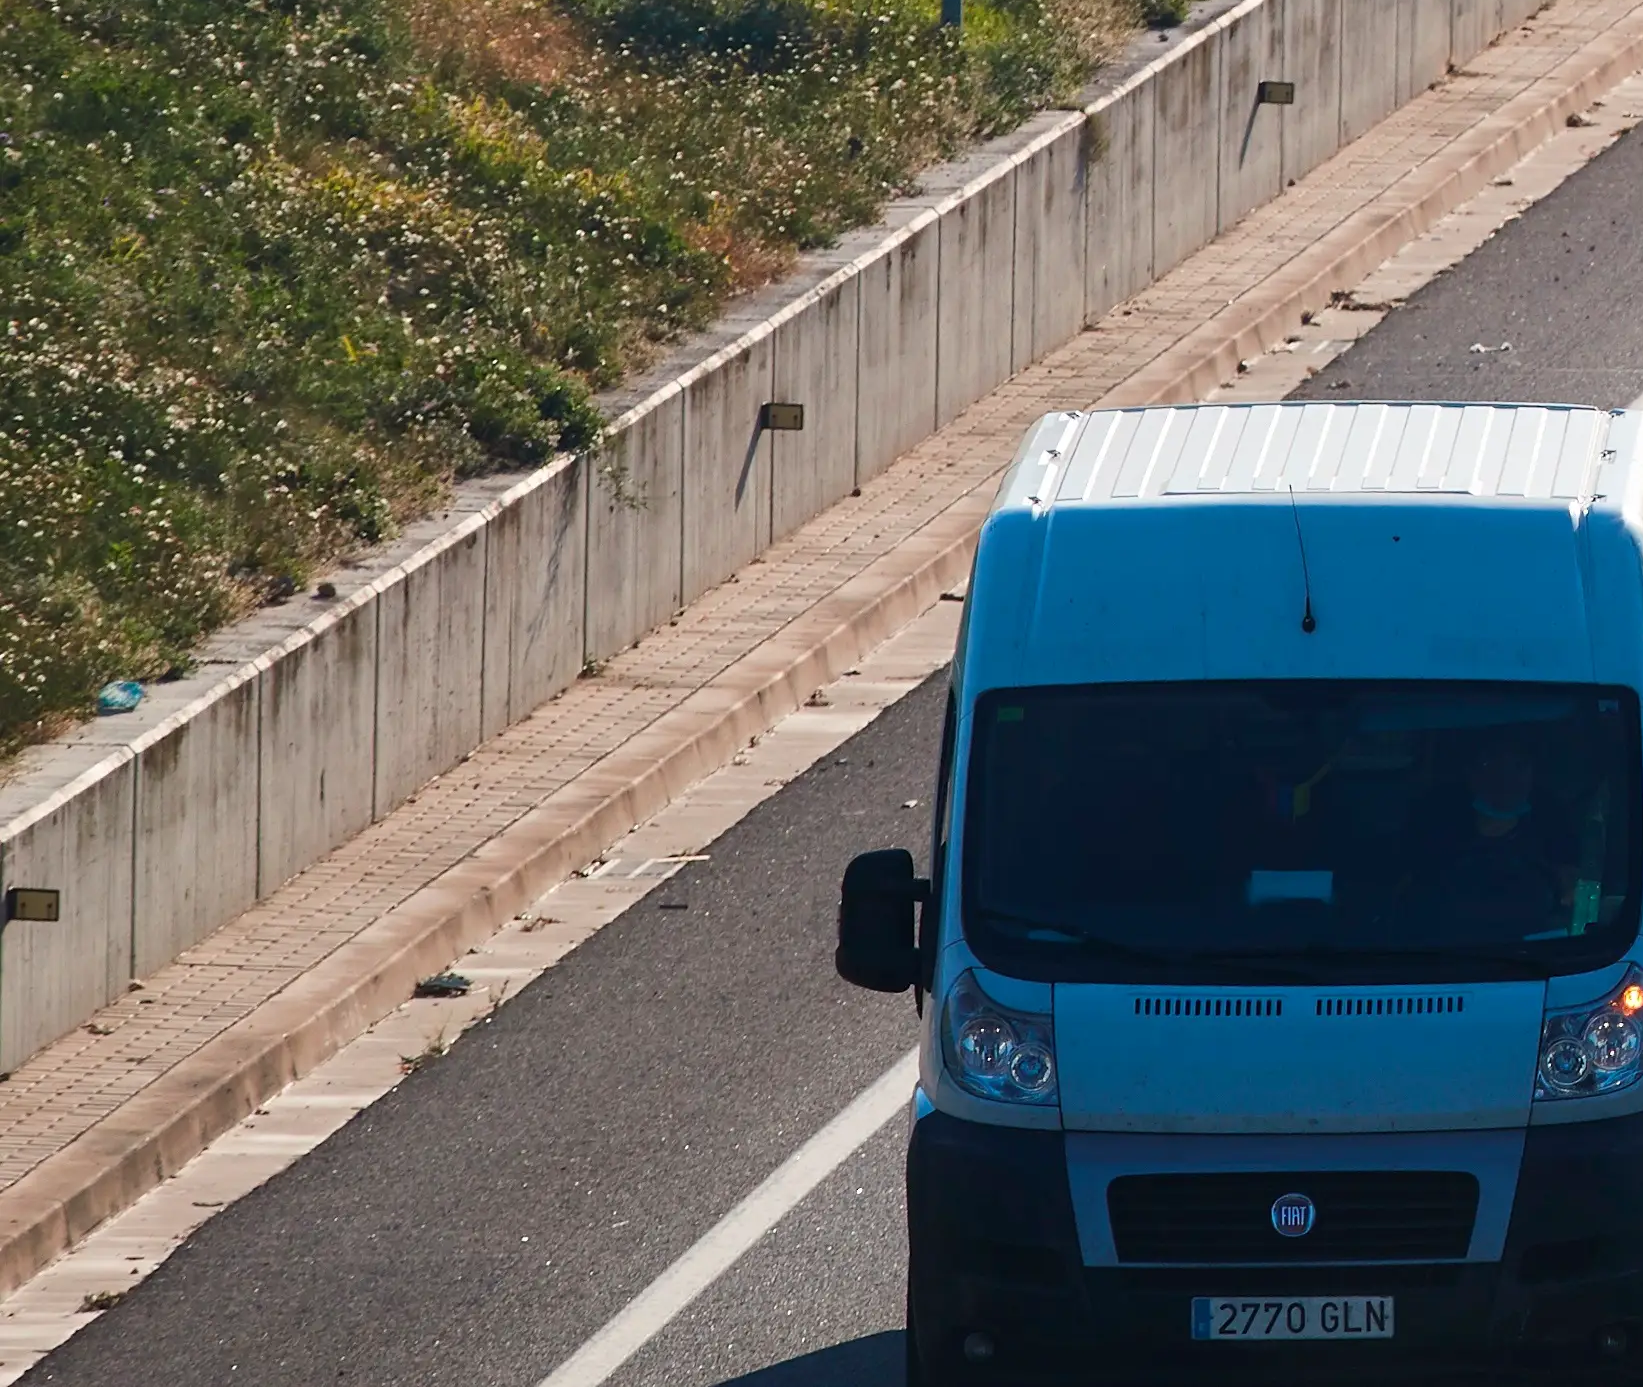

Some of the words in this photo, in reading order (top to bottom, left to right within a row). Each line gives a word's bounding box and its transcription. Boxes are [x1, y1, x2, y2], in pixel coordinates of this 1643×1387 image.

[1281, 1206, 1307, 1226] FIAT
[1218, 1302, 1306, 1335] 2770
[1320, 1300, 1385, 1333] GLN
